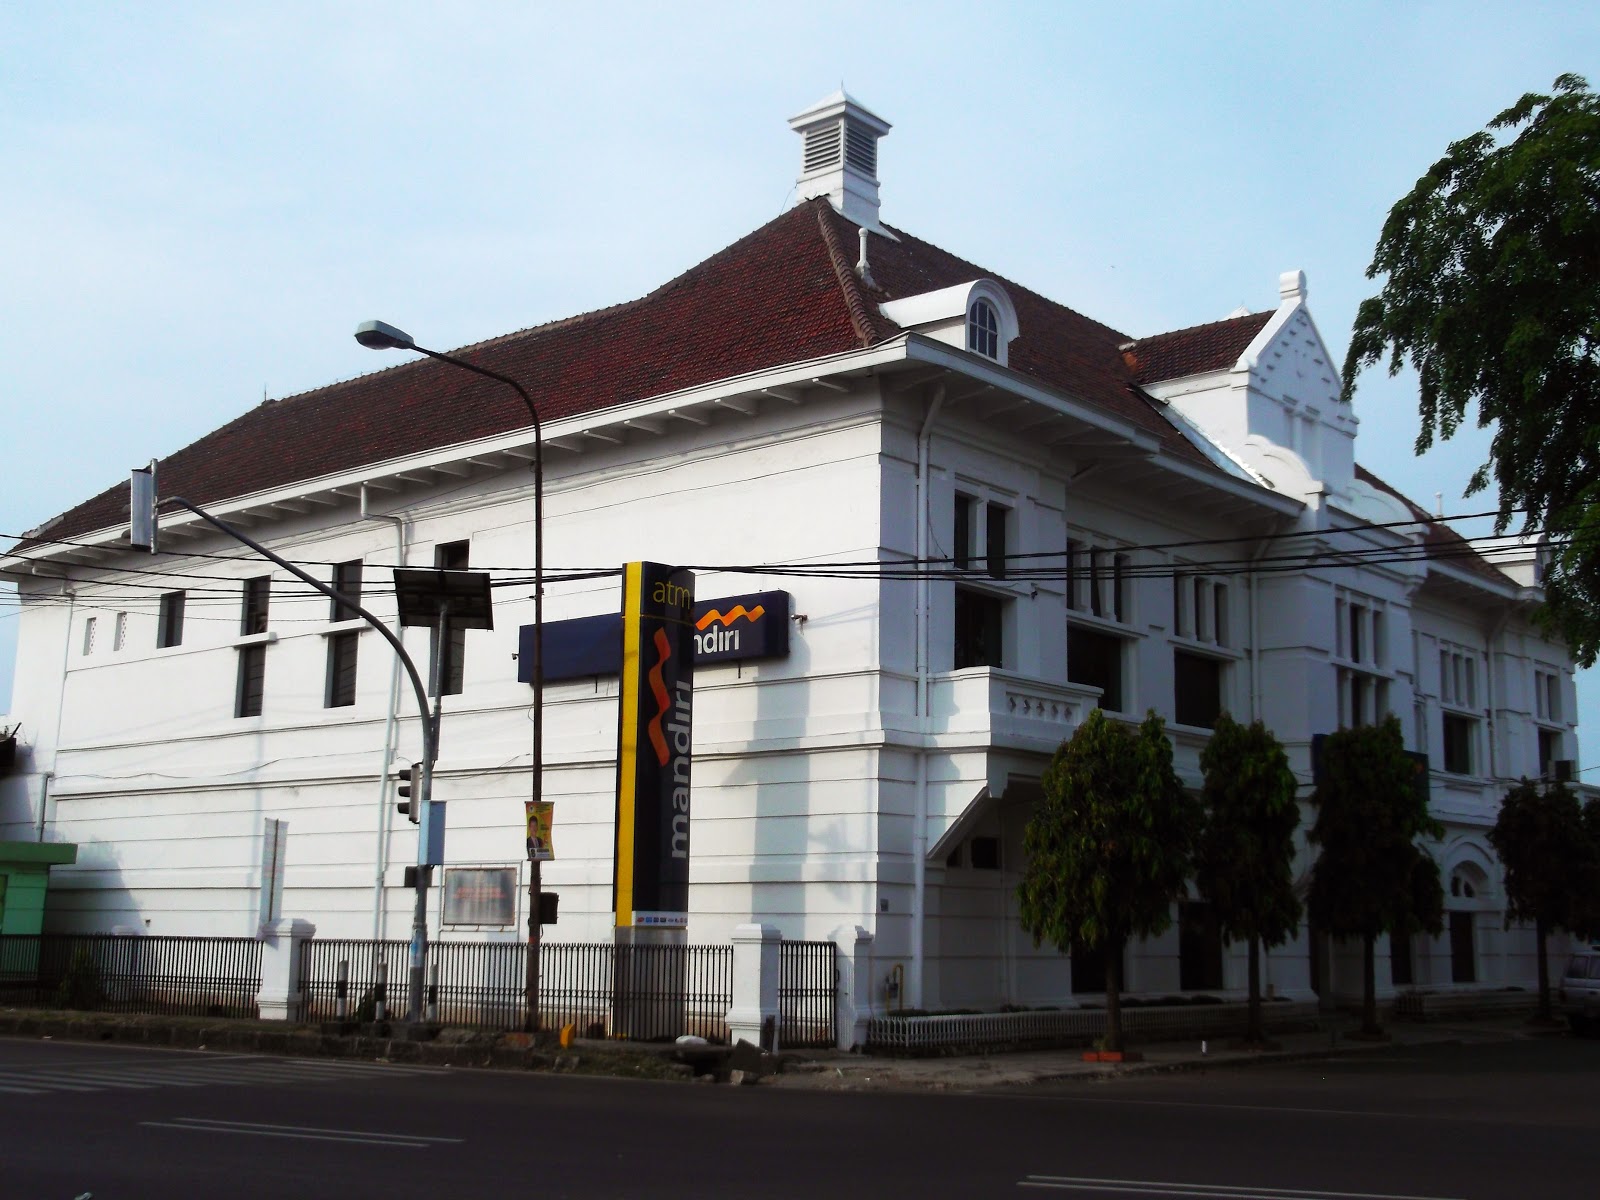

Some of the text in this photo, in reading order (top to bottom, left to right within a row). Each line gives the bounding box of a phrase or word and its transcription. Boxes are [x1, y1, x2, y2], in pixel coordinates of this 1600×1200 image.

[653, 581, 691, 610] atm
[694, 625, 740, 654] ndiri
[668, 680, 691, 859] mandiri
